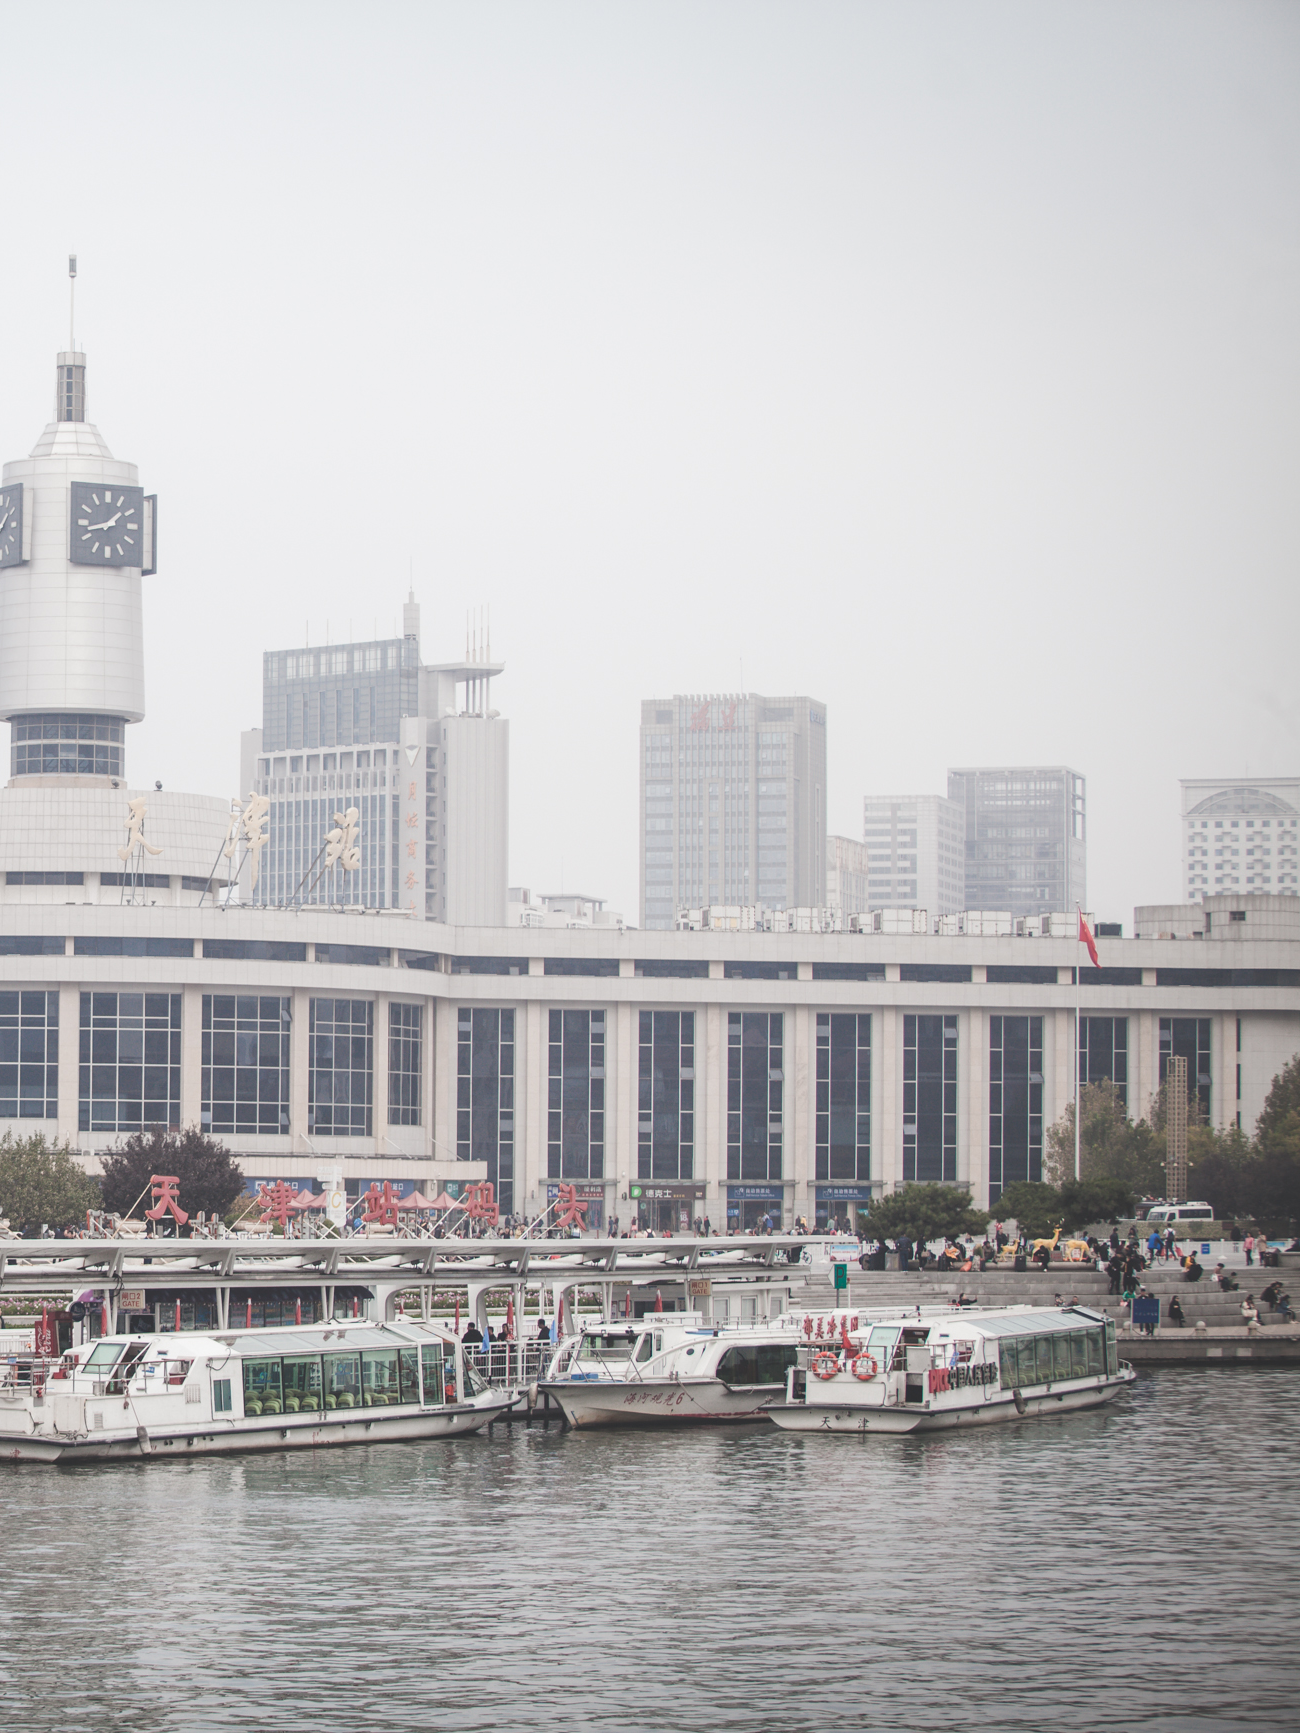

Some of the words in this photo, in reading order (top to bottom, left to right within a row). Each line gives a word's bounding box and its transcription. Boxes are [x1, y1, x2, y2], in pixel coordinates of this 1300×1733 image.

[645, 1189, 672, 1198] 德克士
[145, 1174, 589, 1232] 天津站码头
[836, 1266, 845, 1287] P
[122, 1300, 140, 1308] GATE
[819, 1416, 870, 1431] 天津
